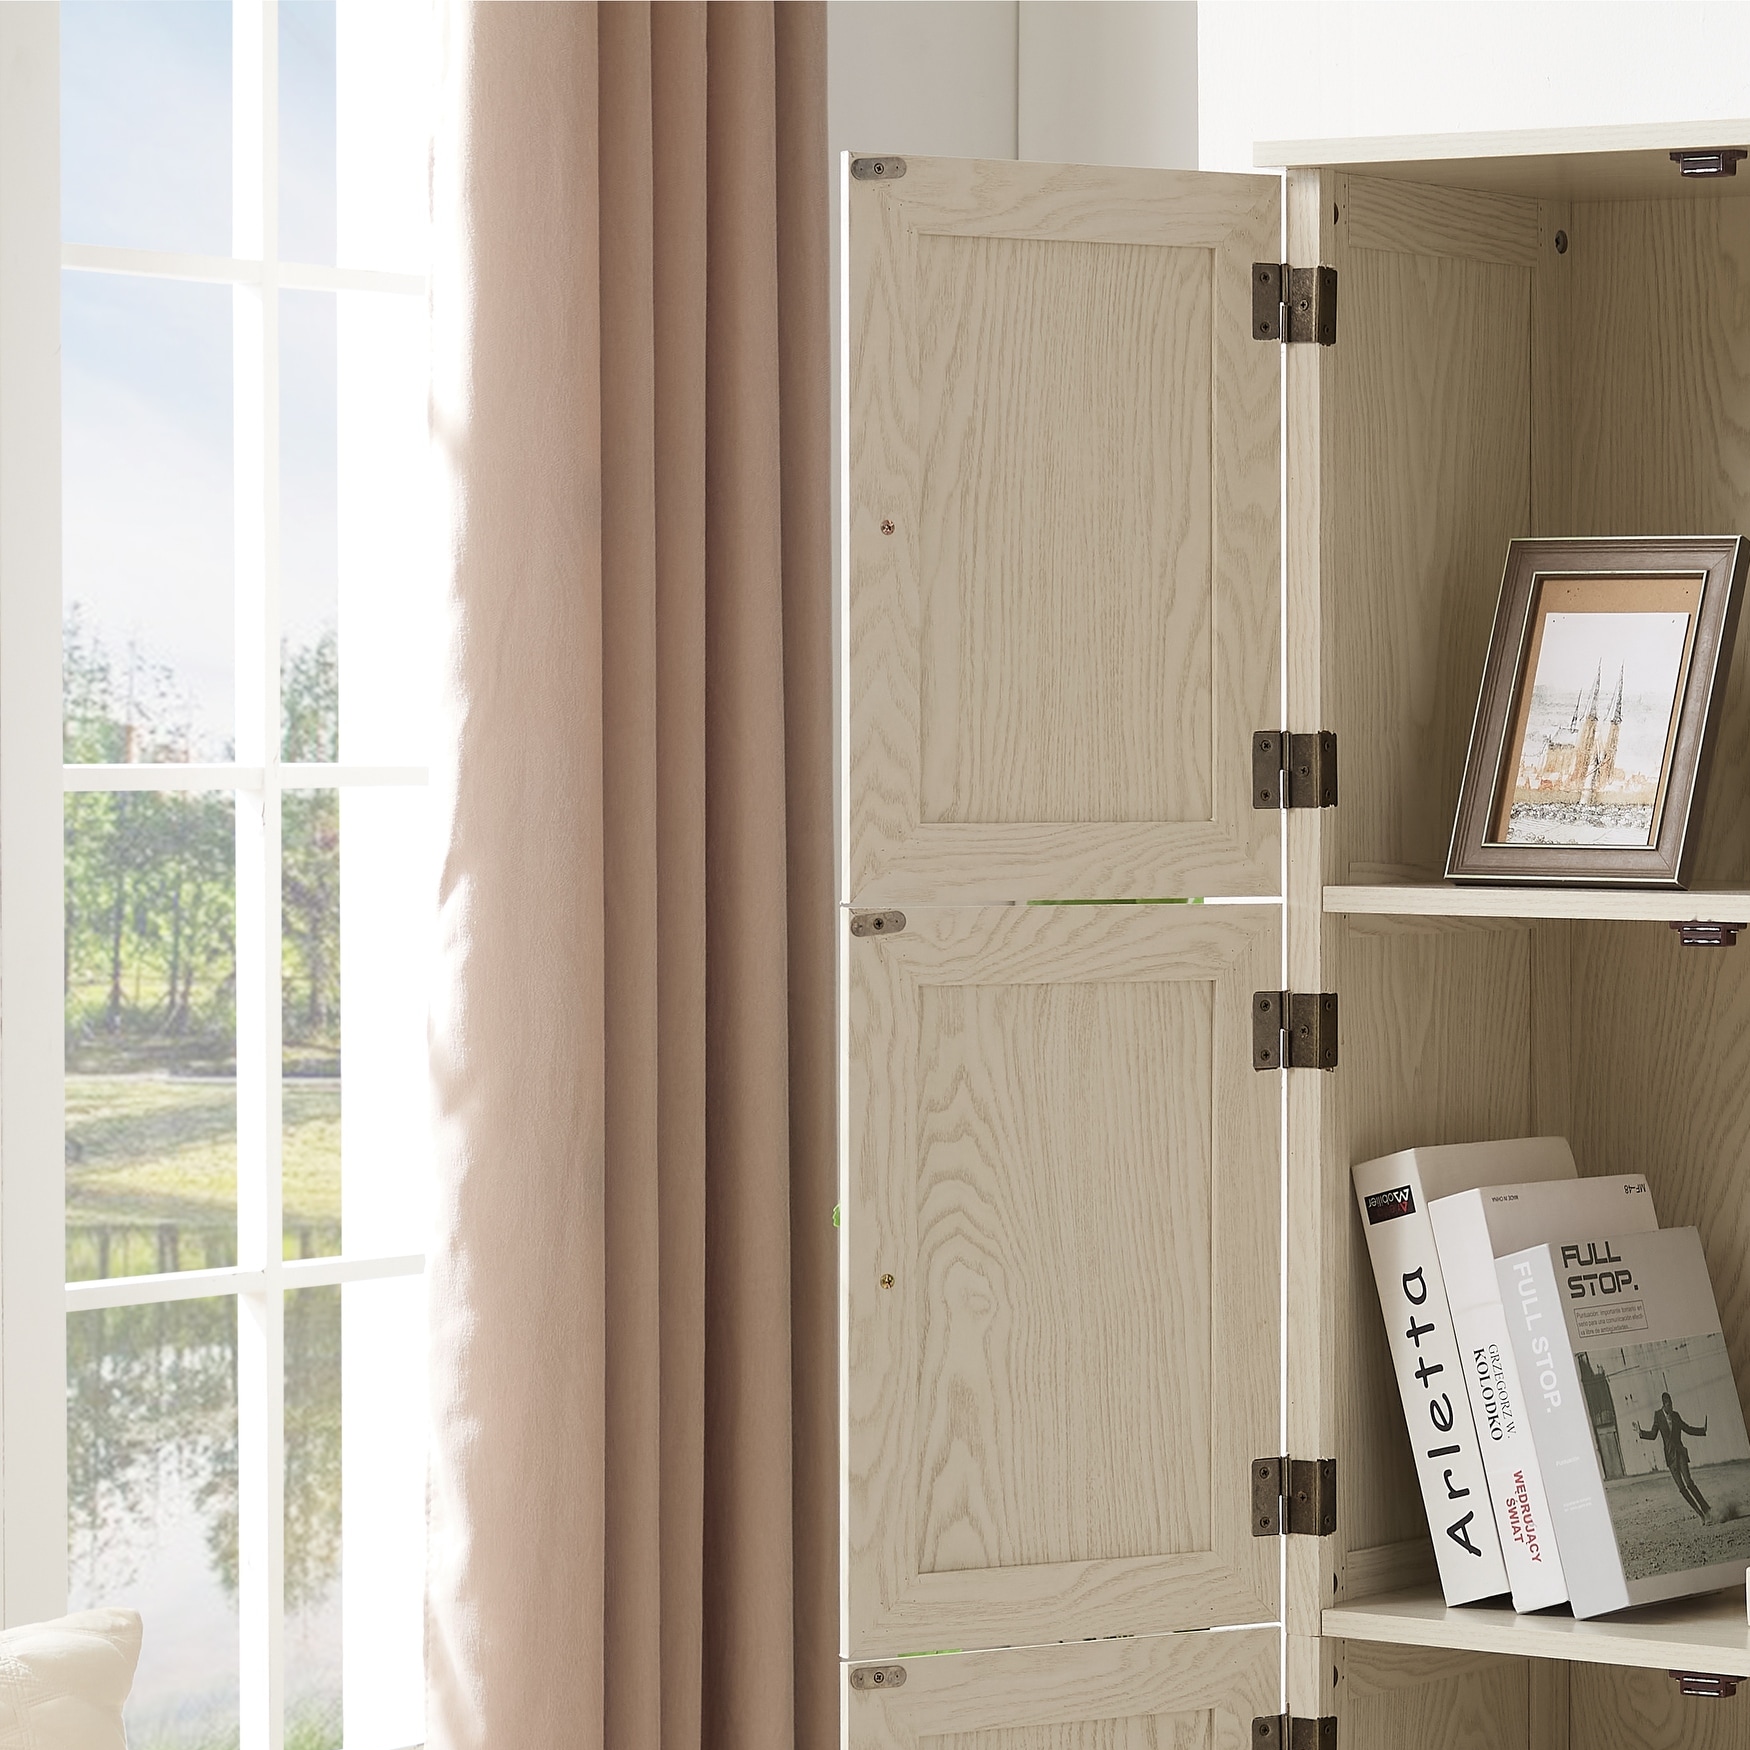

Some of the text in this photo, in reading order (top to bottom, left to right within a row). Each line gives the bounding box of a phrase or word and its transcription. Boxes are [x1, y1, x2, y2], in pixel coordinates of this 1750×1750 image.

[1561, 1241, 1622, 1268] FULL
[1567, 1269, 1639, 1299] STOP.
[1513, 1261, 1562, 1414] FULL STOP.
[1402, 1265, 1482, 1558] Arletta
[1473, 1347, 1504, 1441] KOLODKO
[1488, 1343, 1517, 1439] GRZEGORZ W.
[1505, 1497, 1524, 1543] ŚWIAT
[1513, 1470, 1542, 1563] WĘDRUJĄCY
